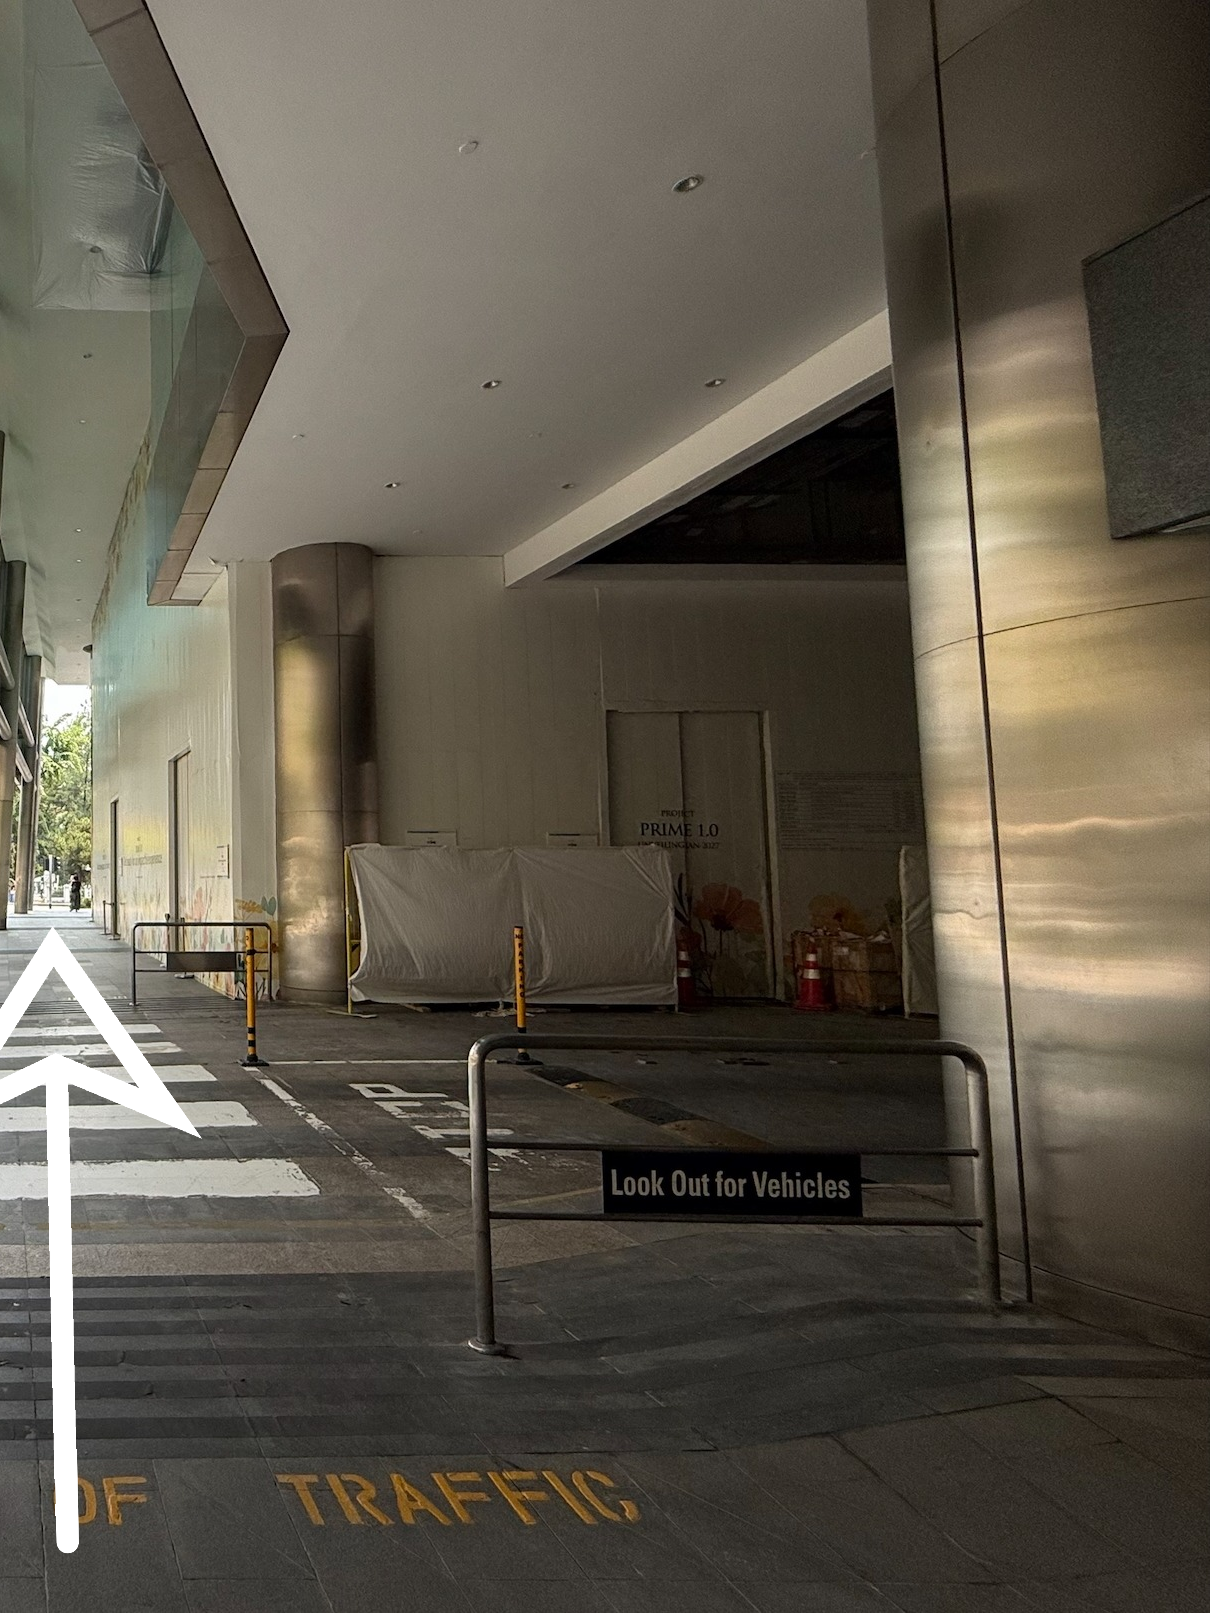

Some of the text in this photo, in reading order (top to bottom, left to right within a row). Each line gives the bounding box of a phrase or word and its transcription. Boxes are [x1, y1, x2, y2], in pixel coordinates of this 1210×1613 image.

[661, 810, 694, 818] PROJECT
[640, 822, 719, 837] PRIME 1.0
[611, 1168, 851, 1199] Look Out for Vehicles
[51, 1475, 148, 1526] OF
[275, 1470, 642, 1527] TRAFFIC
